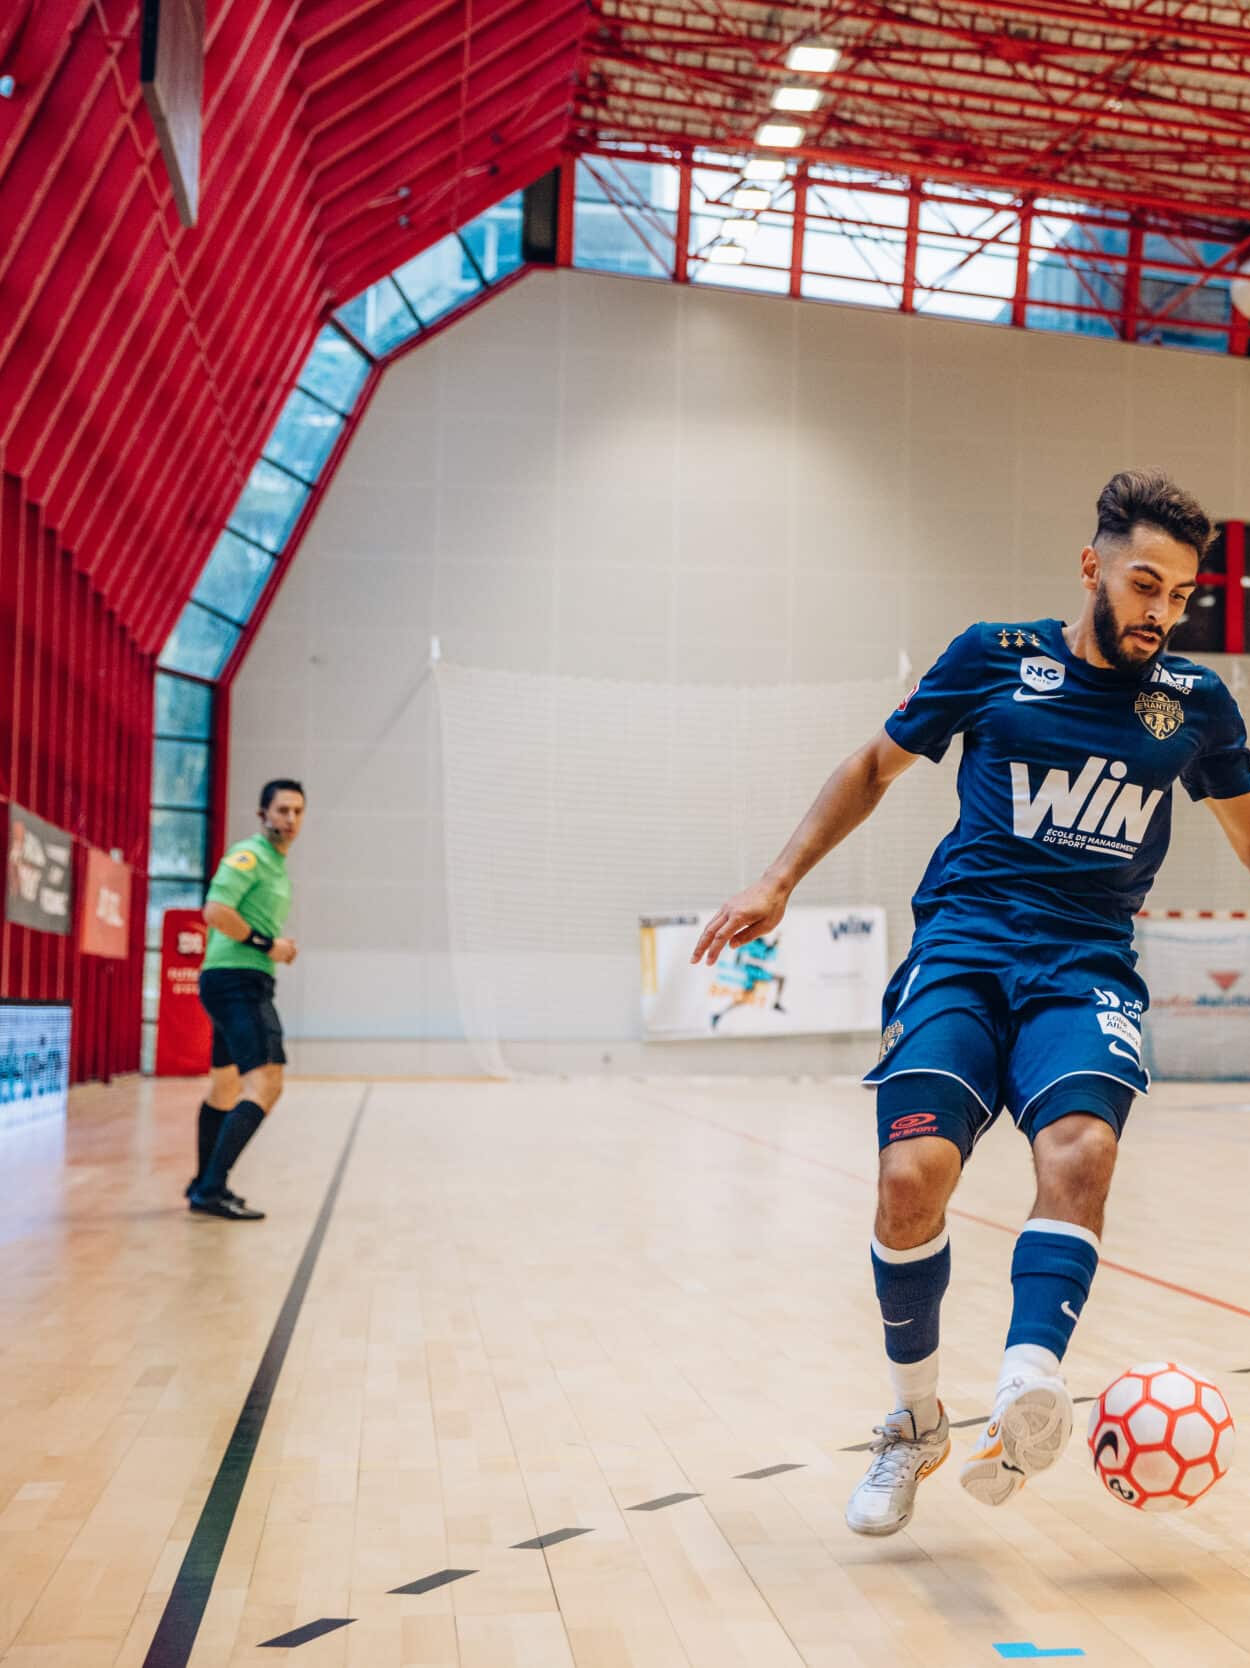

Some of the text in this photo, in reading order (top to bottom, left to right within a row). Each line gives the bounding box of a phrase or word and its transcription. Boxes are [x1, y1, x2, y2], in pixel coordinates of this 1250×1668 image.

[1043, 835, 1086, 849] DU SPORT
[1046, 828, 1138, 853] ÉCOLE DE MANAGEMENT
